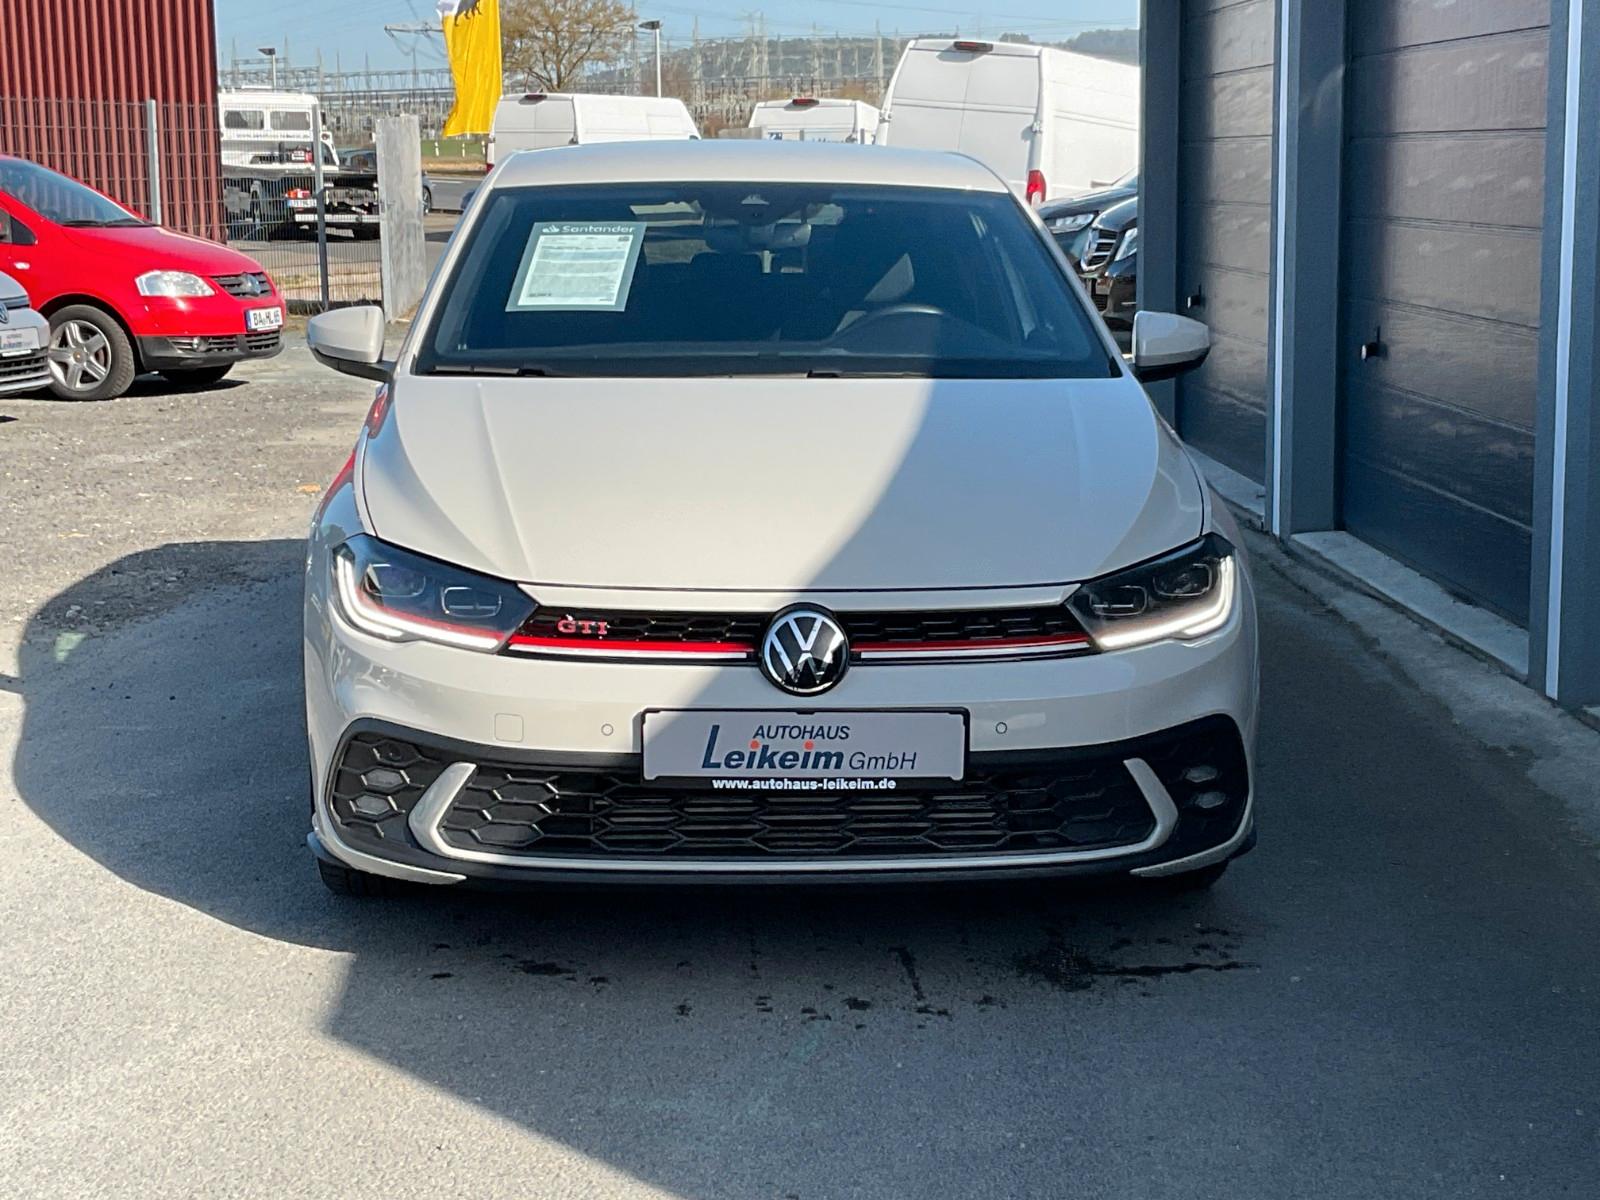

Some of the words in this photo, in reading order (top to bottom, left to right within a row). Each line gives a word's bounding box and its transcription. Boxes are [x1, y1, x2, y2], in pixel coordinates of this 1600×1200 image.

[561, 224, 635, 233] Santander
[557, 618, 608, 635] GTI
[752, 725, 850, 740] AUTOHAUS
[701, 724, 844, 770] Leikeim
[849, 751, 917, 770] GmbH
[712, 778, 897, 790] www.autohaus-leikeim.de
